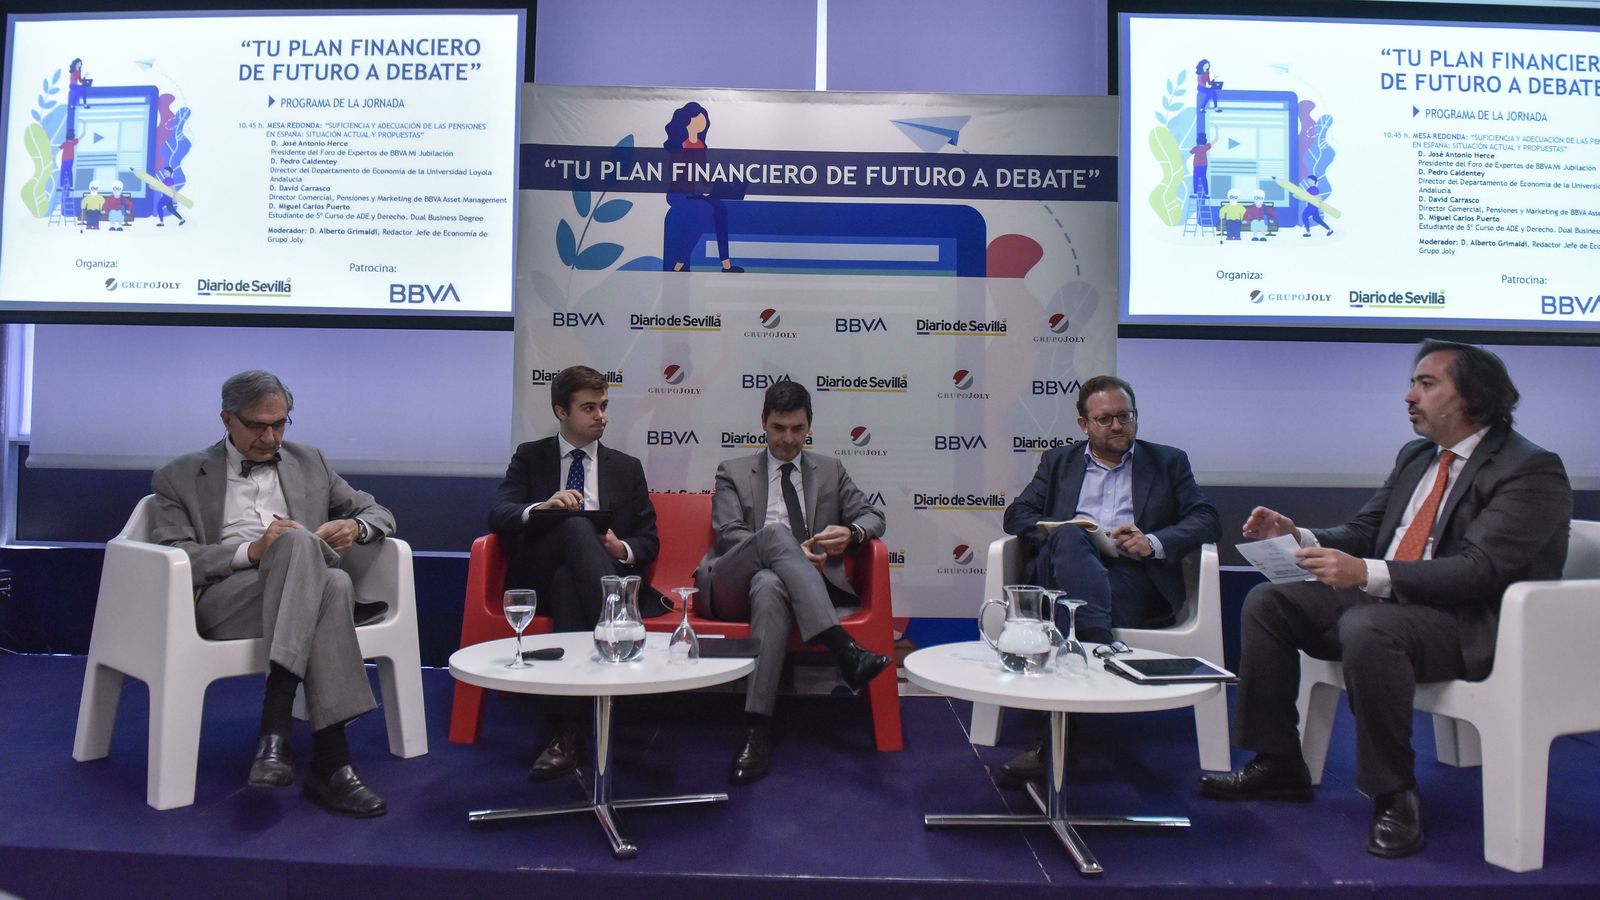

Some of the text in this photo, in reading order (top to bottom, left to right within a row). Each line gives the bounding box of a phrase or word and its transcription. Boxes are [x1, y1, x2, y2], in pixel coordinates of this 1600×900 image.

[289, 40, 341, 56] PLAN
[351, 39, 481, 56] FINANCIERO
[1430, 50, 1483, 68] PLAN
[1492, 52, 1600, 72] FINANCIER
[239, 64, 264, 80] DE
[273, 64, 359, 80] FUTURO
[365, 64, 379, 80] A
[1381, 73, 1406, 90] DE
[1416, 74, 1501, 93] FUTURO
[1508, 77, 1521, 93] A
[281, 98, 404, 109] PROGRAMA DE LA JORNADA
[1425, 109, 1548, 122] PROGRAMA DE LA JORNADA
[302, 158, 337, 166] Caldentey
[469, 169, 492, 177] Loyola
[601, 160, 662, 182] PLAN
[672, 163, 817, 184] FINANCIERO
[827, 166, 857, 185] DE
[867, 167, 965, 187] FUTURO
[972, 168, 990, 187] A
[279, 203, 301, 211] Miguel
[463, 197, 507, 205] Management
[347, 228, 379, 236] Grimaldi,
[75, 258, 118, 271] Organiza:
[349, 262, 397, 274] Patrocina:
[1216, 271, 1263, 281] Organiza:
[1501, 275, 1547, 285] Patrocina:
[198, 278, 291, 292] Diario de Sevilla
[389, 284, 460, 303] BBVA
[1350, 291, 1445, 304] Diario de Sevilla
[553, 312, 604, 327] BBVA
[631, 314, 721, 327] Diario de Sevilla
[836, 318, 887, 332] BBVA
[917, 320, 1007, 332] Diario de Sevilla
[817, 376, 907, 389] Diario de Sevilla
[1032, 380, 1081, 394] BBVA
[648, 430, 699, 445] BBVA
[722, 432, 757, 444] Diario
[935, 435, 986, 450] BBVA
[1013, 437, 1048, 448] Diario
[1050, 438, 1064, 449] de
[914, 494, 1005, 507] Diario de Sevilla
